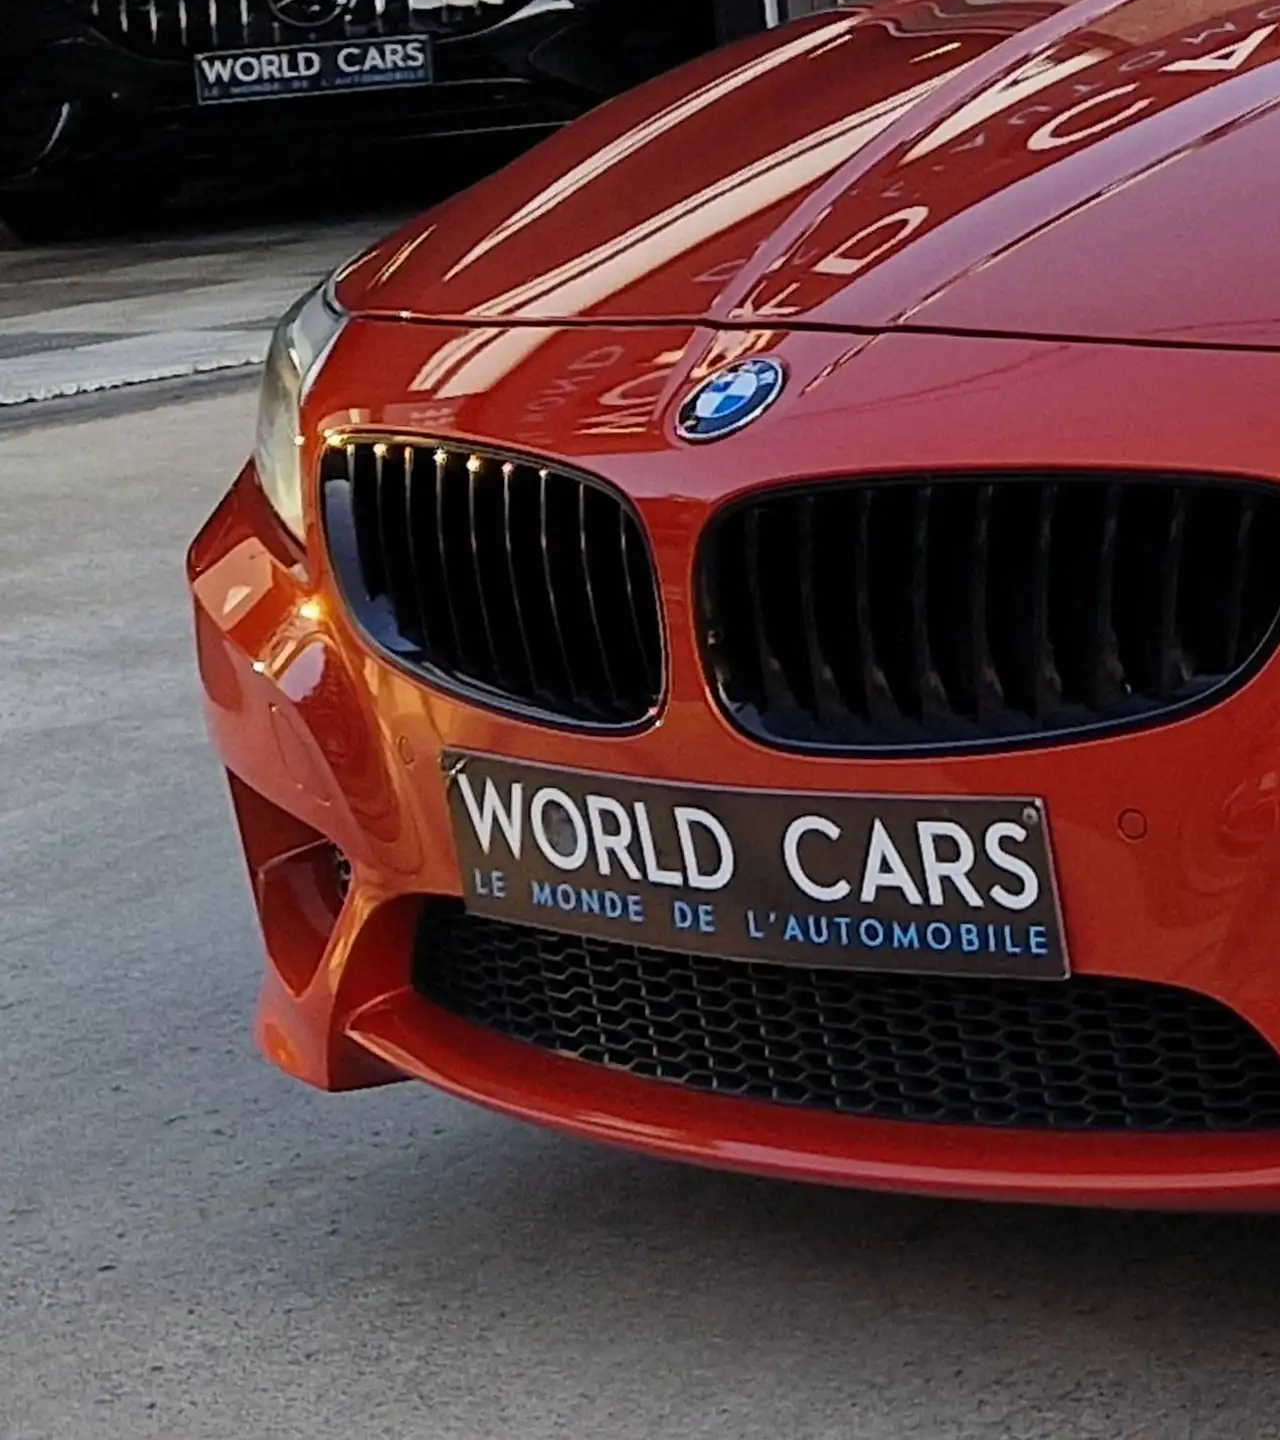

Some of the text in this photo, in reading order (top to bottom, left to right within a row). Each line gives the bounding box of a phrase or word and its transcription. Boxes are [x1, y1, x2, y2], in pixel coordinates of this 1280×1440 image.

[200, 42, 425, 84] WORLD CARS
[456, 772, 1041, 911] WORLD CARS
[473, 867, 1051, 956] LE MONDE DE L'AUTOMOBILE
